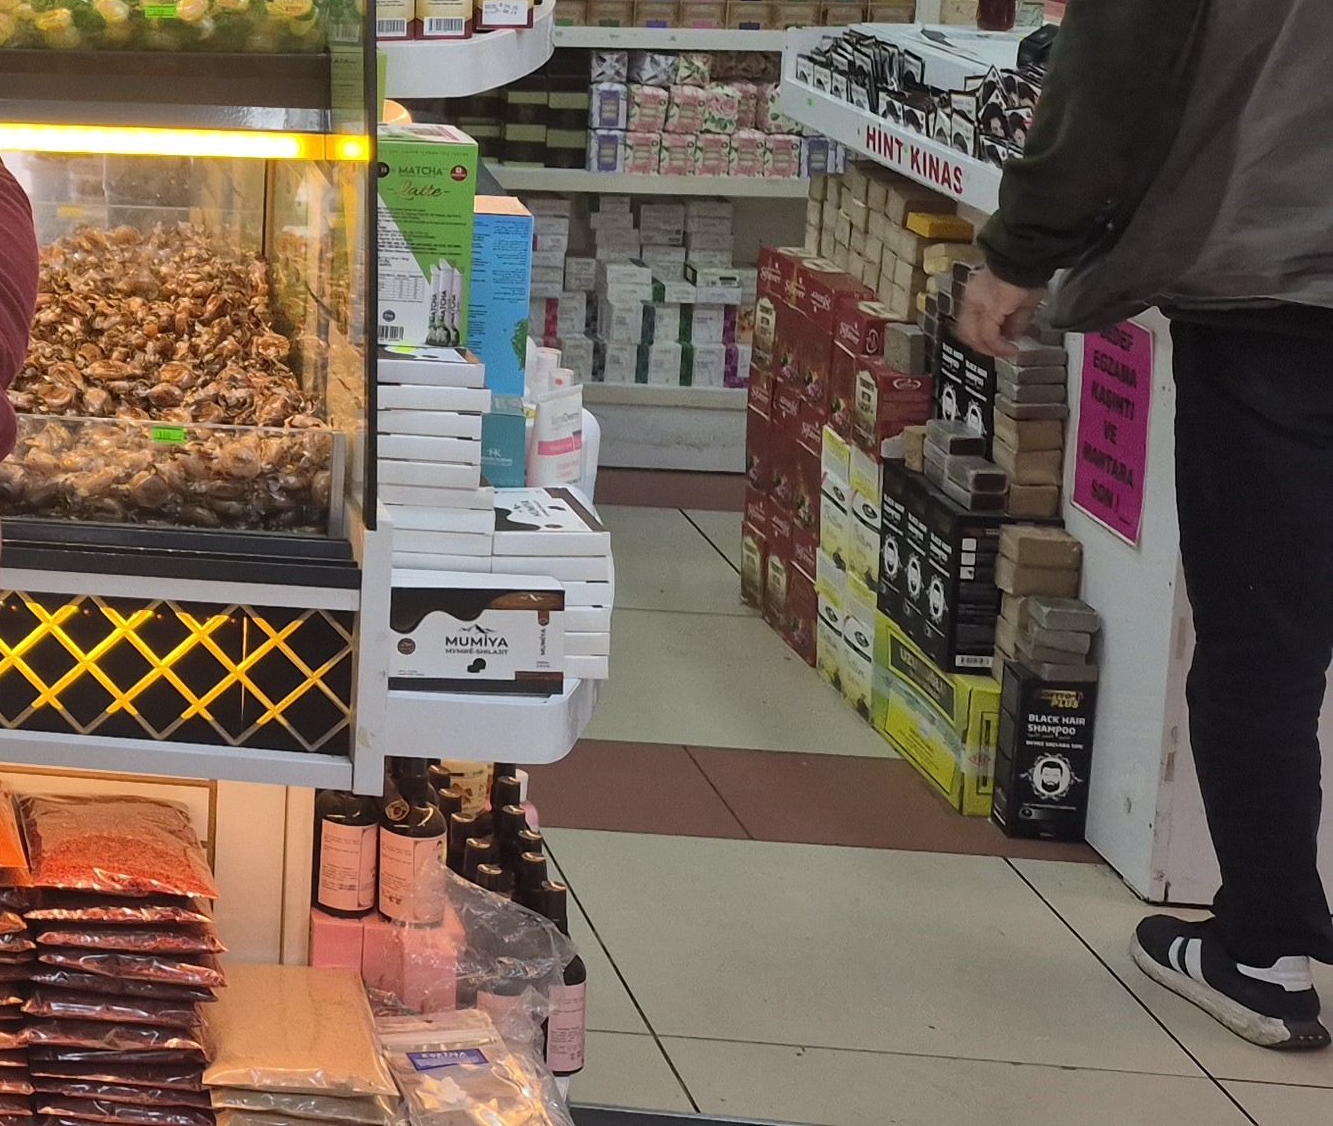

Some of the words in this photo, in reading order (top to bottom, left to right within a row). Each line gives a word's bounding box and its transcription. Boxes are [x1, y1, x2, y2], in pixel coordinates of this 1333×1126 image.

[866, 122, 904, 165] HİNT
[910, 144, 963, 195] KINAS
[398, 164, 444, 177] MATCHA
[397, 178, 443, 201] Latte
[1104, 420, 1118, 445] VE
[445, 632, 509, 648] MUMİYA
[1050, 698, 1080, 709] PLUS
[1028, 713, 1060, 724] BLACK
[1061, 716, 1086, 726] HAIR
[1027, 723, 1077, 737] SHAMPOO
